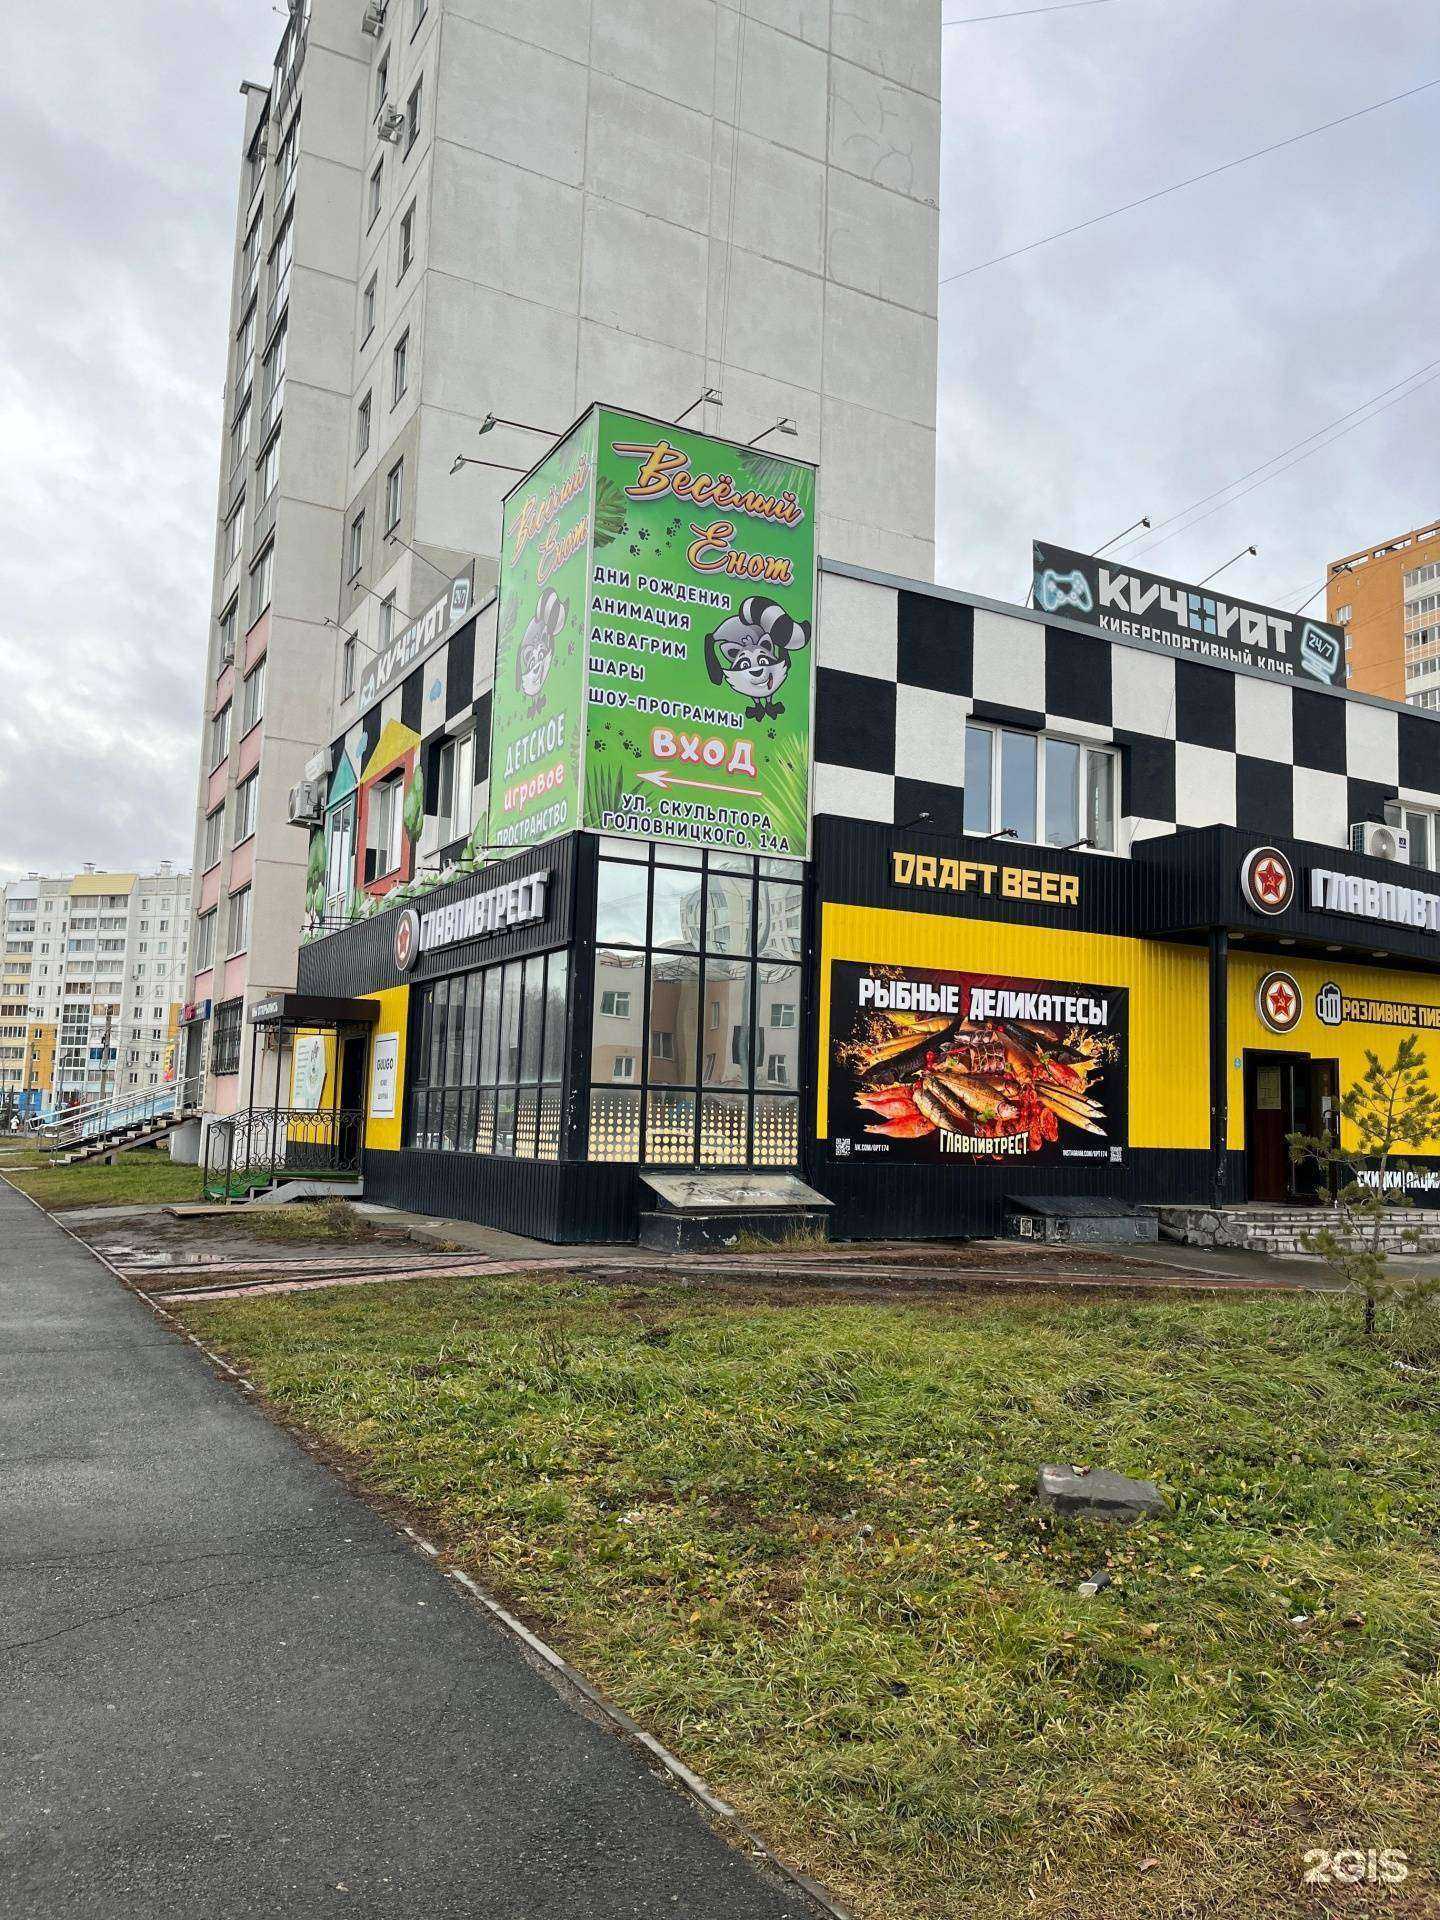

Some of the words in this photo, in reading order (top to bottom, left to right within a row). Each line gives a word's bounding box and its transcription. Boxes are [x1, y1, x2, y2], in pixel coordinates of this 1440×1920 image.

[611, 440, 804, 527] Весёлый
[686, 520, 794, 585] Енот
[594, 566, 630, 586] ДНИ
[638, 576, 731, 609] РОЖДЕНИЯ
[591, 597, 690, 630] АНИМАЦИЯ
[591, 627, 687, 659] АКВАГРИМ
[1099, 614, 1252, 665] КИБЕРСПОРТИВНЫЙ
[1308, 633, 1333, 658] 24/7
[588, 656, 645, 681] ШАРЫ
[588, 687, 744, 729] ШОУ-ПРОГРАММЫ
[504, 713, 565, 780] ДЕТСКОЕ
[652, 727, 757, 778] ВХОД
[496, 799, 567, 851] ПРОСТРАНСТВО
[601, 811, 752, 848] ГОЛОВНИЦКОГО,
[759, 832, 790, 852] 14А
[621, 792, 652, 814] УЛ.
[659, 799, 772, 830] СКУЛЬПТОРА
[892, 851, 998, 895] DRAFT
[1001, 866, 1079, 905] BEER
[1311, 868, 1440, 931] ГЛАВПИВТ
[419, 872, 548, 951] ГЛАВПИВТРЕСТ
[859, 977, 960, 1014] РЫБНЫЕ
[969, 988, 1108, 1026] ДЕЛИКАТЕСЫ
[1342, 999, 1416, 1025] РАЗЛИВНОЕ
[939, 1128, 1029, 1155] ГЛАВПИВТРЕСТ
